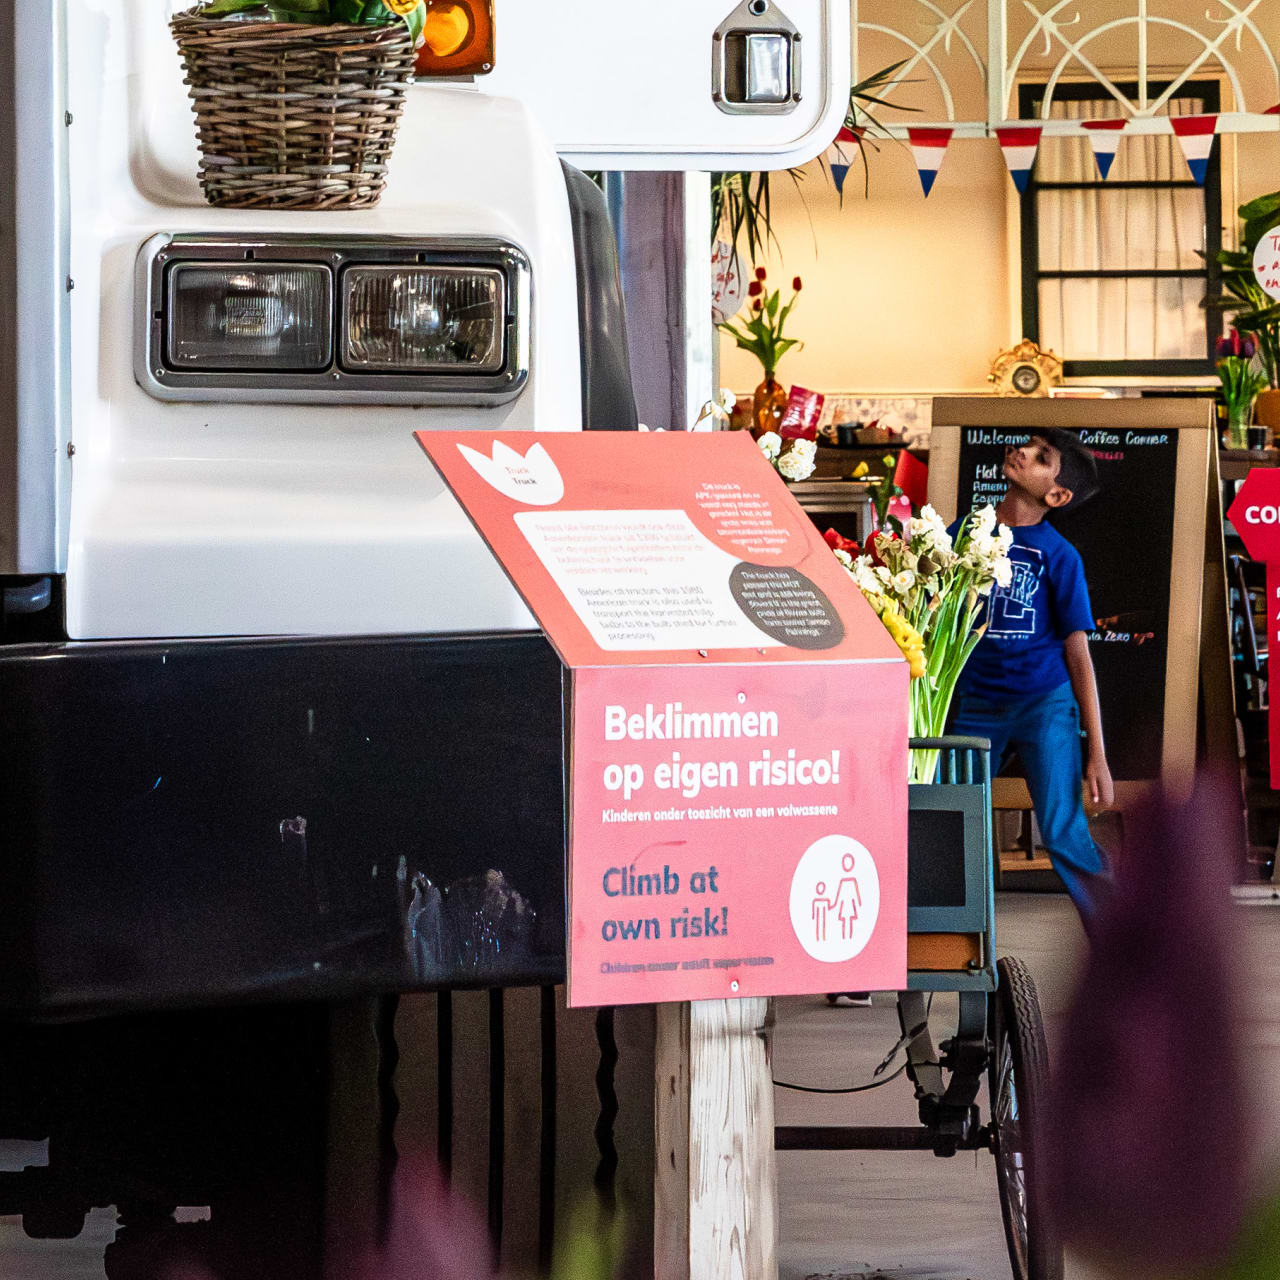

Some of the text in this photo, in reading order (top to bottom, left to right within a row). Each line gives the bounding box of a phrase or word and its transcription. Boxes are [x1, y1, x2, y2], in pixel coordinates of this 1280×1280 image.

[972, 481, 1008, 493] Ameri
[975, 464, 998, 480] Hot
[604, 702, 778, 742] Beklimmen
[603, 748, 841, 800] op eigen risico!
[602, 803, 839, 823] Kinderen onder toezicht van een volwassene
[602, 864, 720, 898] Climb at
[601, 906, 729, 942] own risk!
